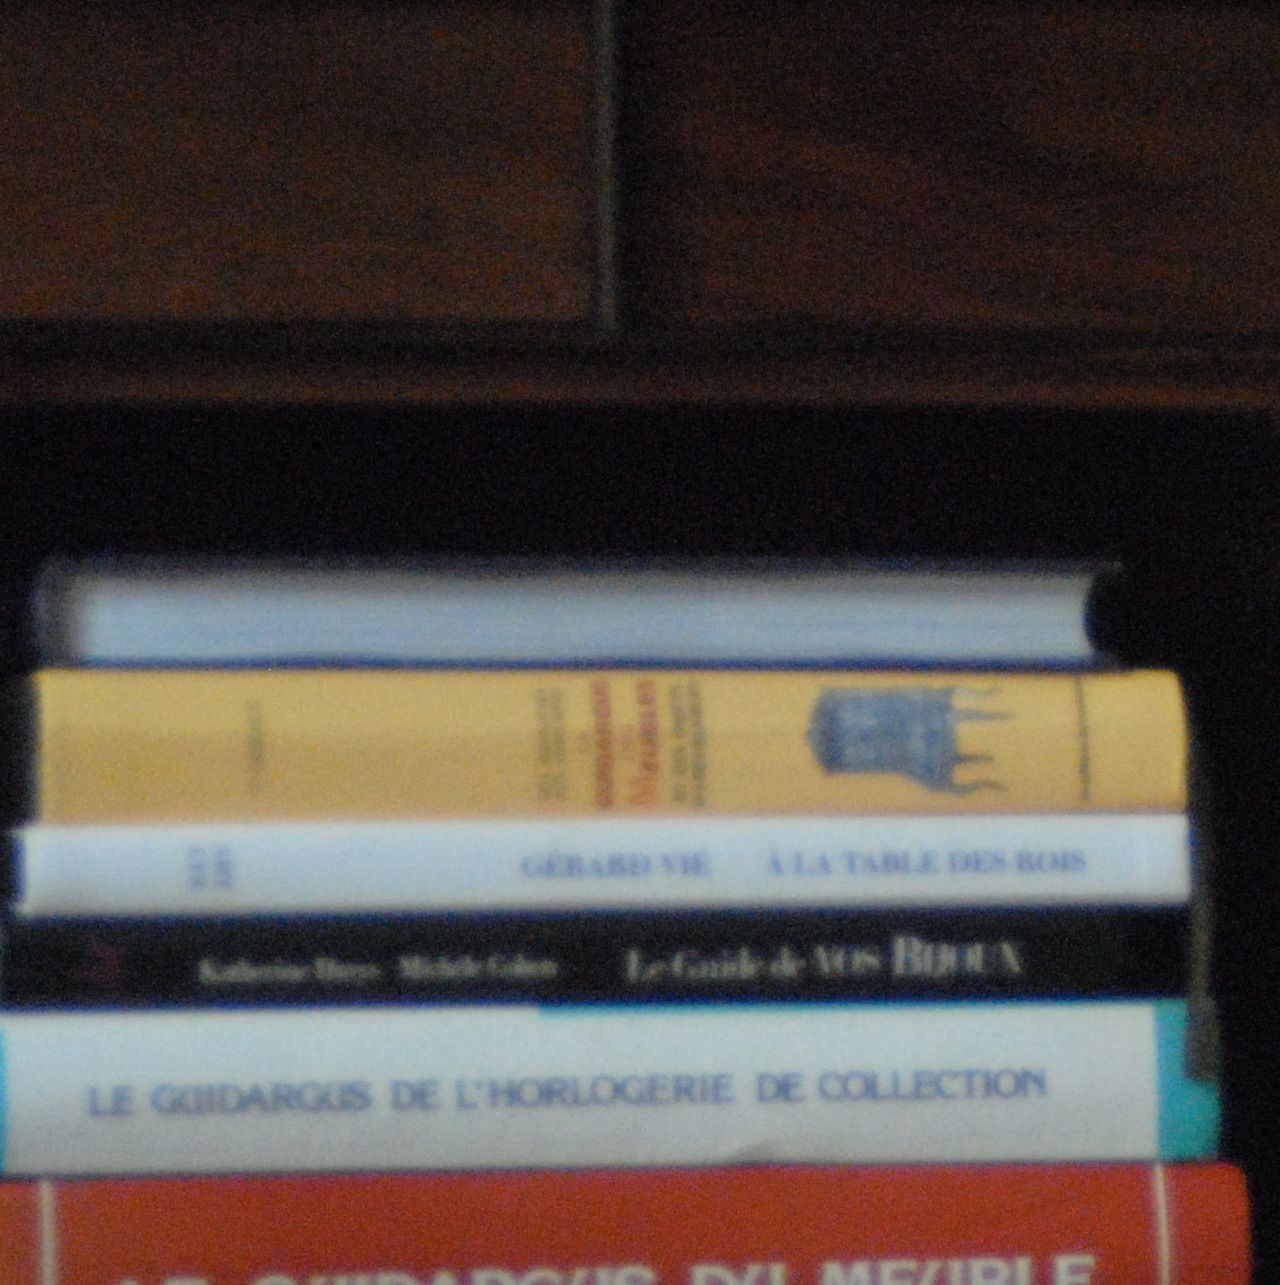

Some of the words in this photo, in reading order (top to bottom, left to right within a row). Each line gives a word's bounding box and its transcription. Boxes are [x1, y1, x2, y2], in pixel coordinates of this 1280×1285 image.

[793, 850, 833, 876] LA
[842, 849, 939, 876] TABLE
[948, 848, 1007, 875] DES
[88, 1083, 135, 1119] LE
[149, 1080, 375, 1116] GUIDARGUS
[391, 1078, 440, 1112] DE
[456, 1071, 734, 1110] L'HORLOGERIE
[757, 1070, 801, 1104] DE
[817, 1066, 1048, 1103] COLLECTION
